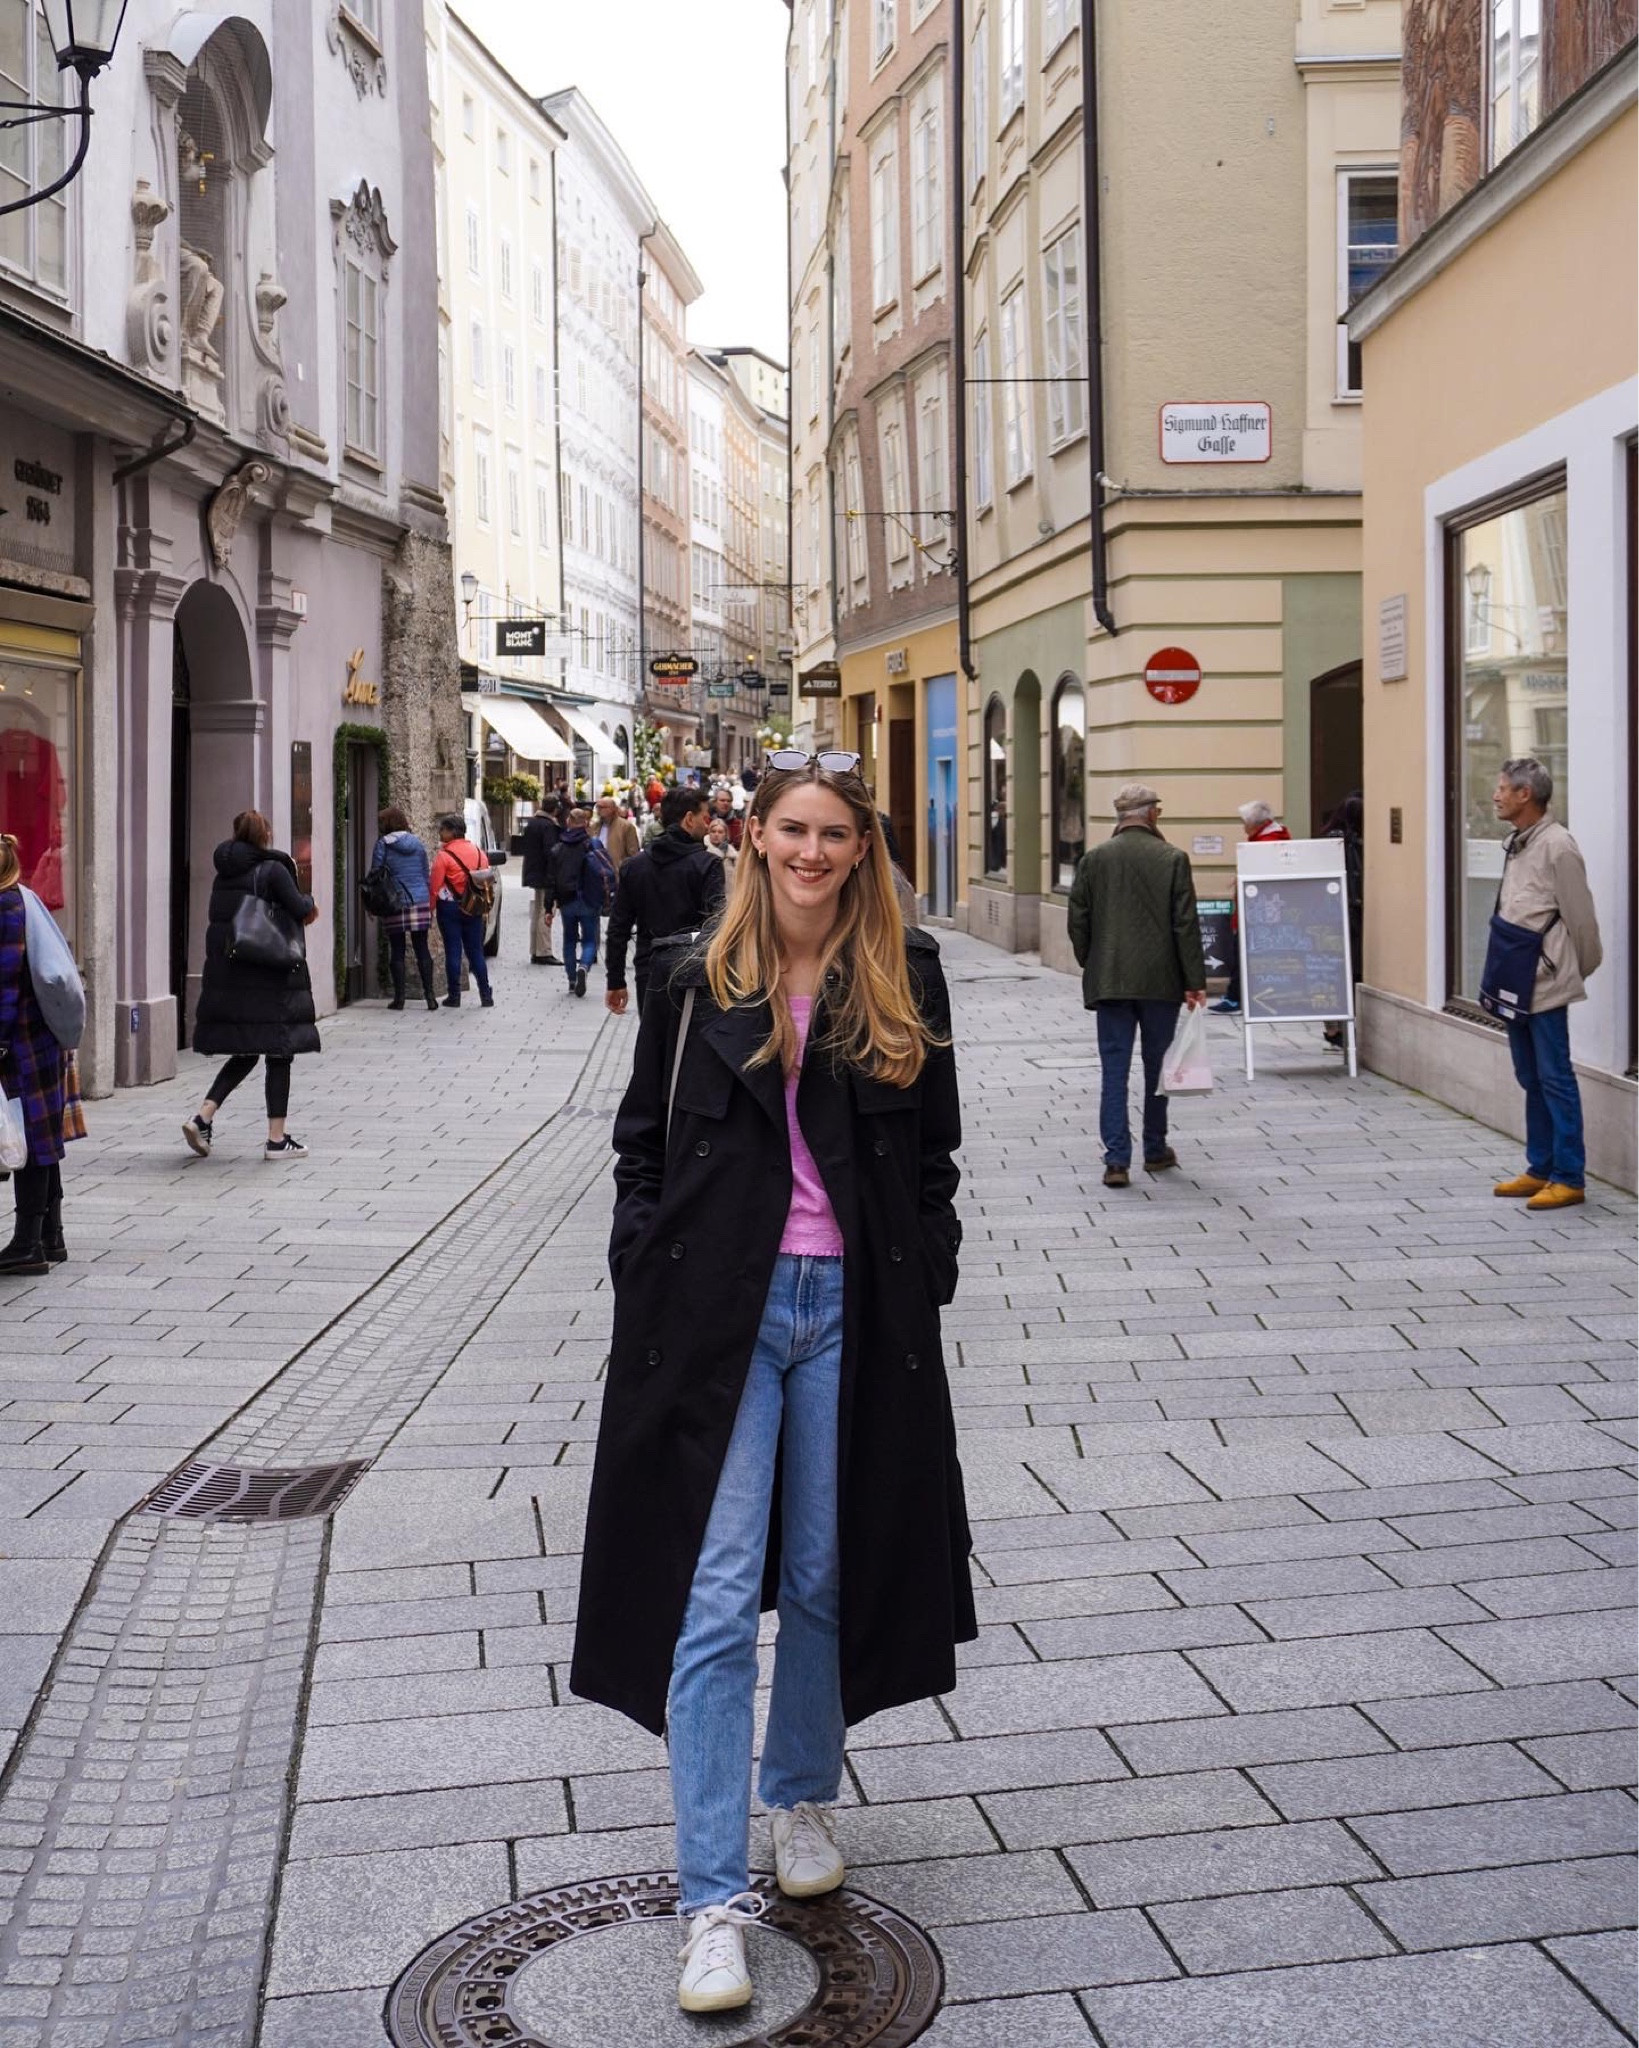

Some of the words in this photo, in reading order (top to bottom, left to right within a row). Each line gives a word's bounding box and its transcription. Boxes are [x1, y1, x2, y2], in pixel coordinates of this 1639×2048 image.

[1164, 414, 1217, 434] Sigmund
[1221, 413, 1267, 433] Haffner
[505, 631, 533, 640] MONT
[505, 639, 533, 647] BLANC
